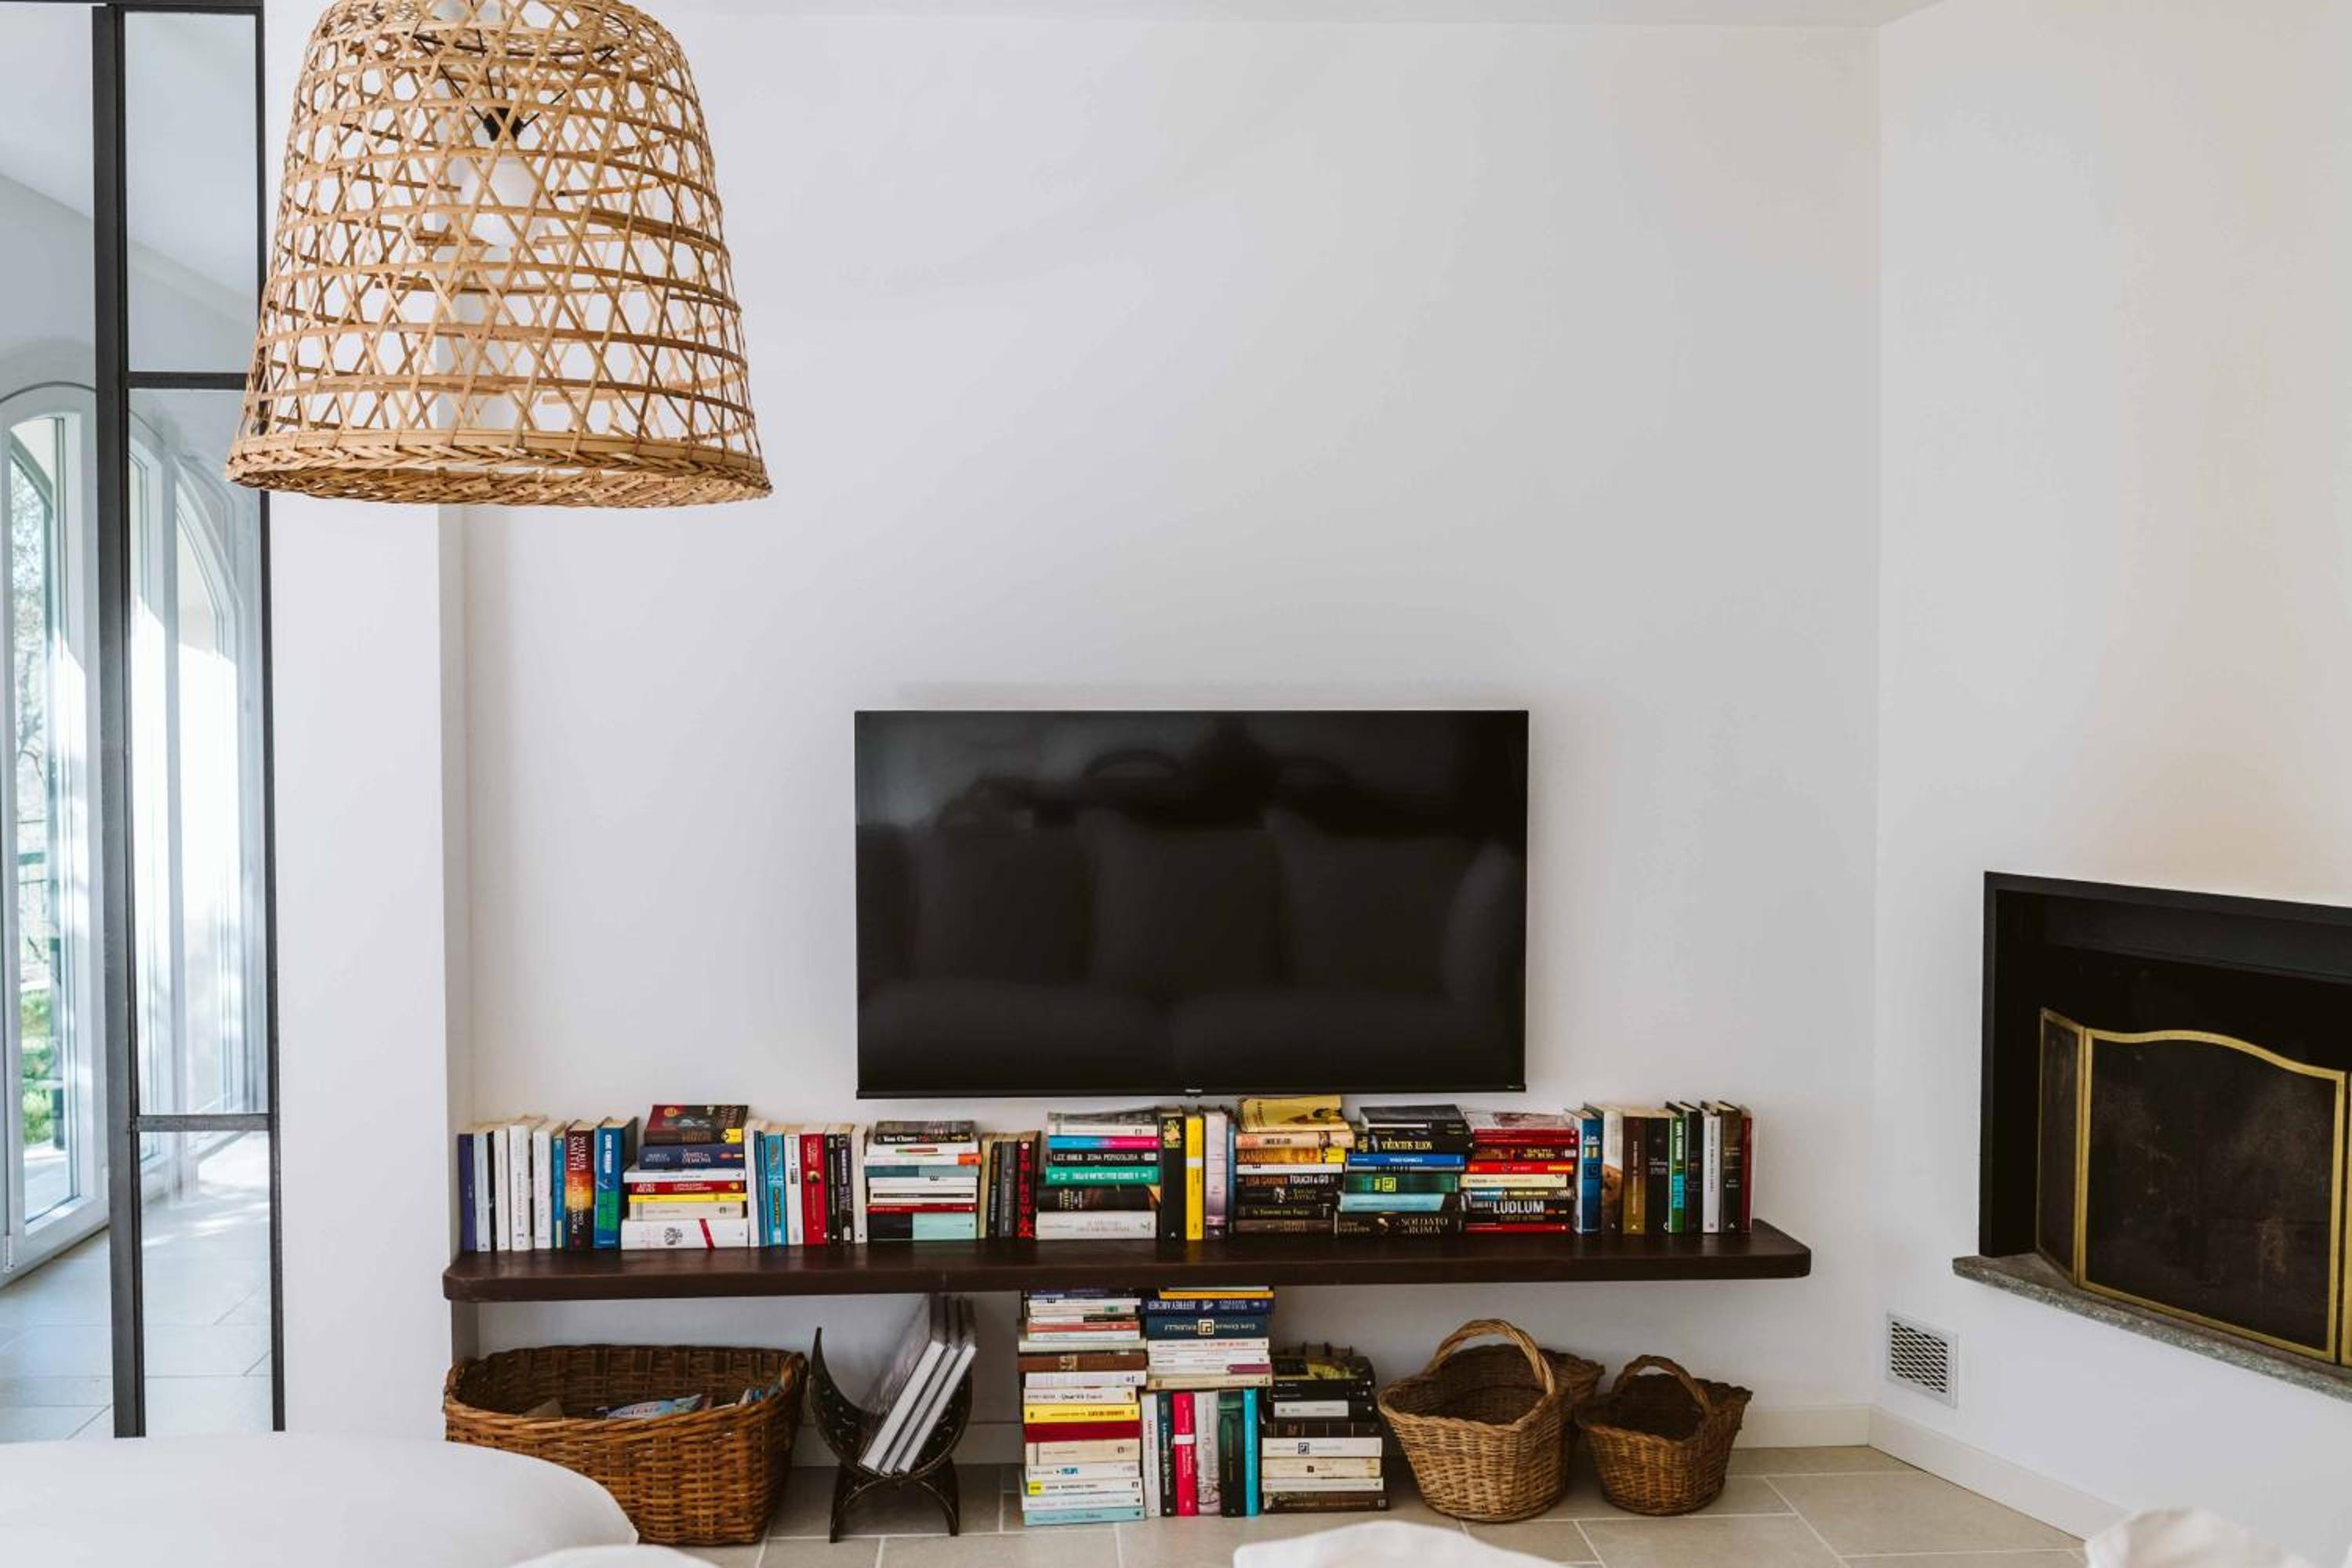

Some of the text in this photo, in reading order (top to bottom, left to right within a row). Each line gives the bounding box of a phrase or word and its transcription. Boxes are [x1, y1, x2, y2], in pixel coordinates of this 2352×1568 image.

[569, 1136, 586, 1171] WILBUR SMITH
[1493, 1200, 1544, 1214] LUDLUM
